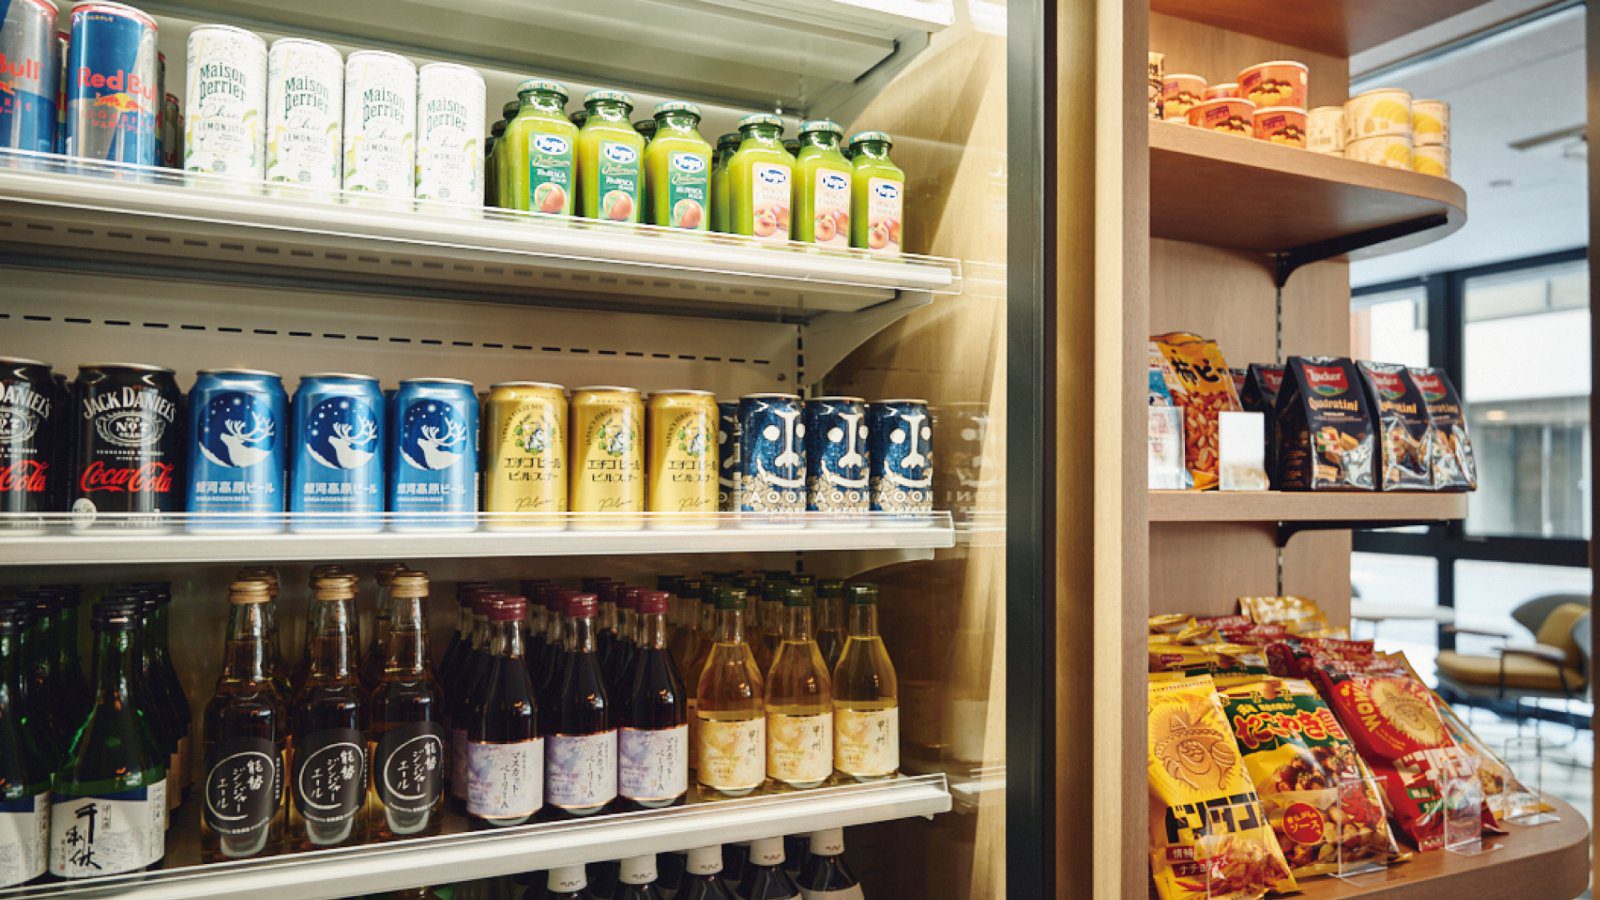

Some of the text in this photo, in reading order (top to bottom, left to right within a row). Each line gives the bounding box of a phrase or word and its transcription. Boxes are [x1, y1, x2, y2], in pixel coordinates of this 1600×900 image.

[78, 67, 124, 91] Red
[200, 62, 246, 87] Maison
[285, 76, 329, 100] Maison
[363, 87, 404, 111] Maison
[427, 97, 467, 120] Maison
[83, 386, 176, 423] JACK DANIEL'S
[1308, 397, 1359, 412] Quadratini
[80, 460, 174, 493] Coca-Cola
[311, 768, 323, 798] エール
[397, 760, 409, 791] エール
[217, 777, 229, 809] エール
